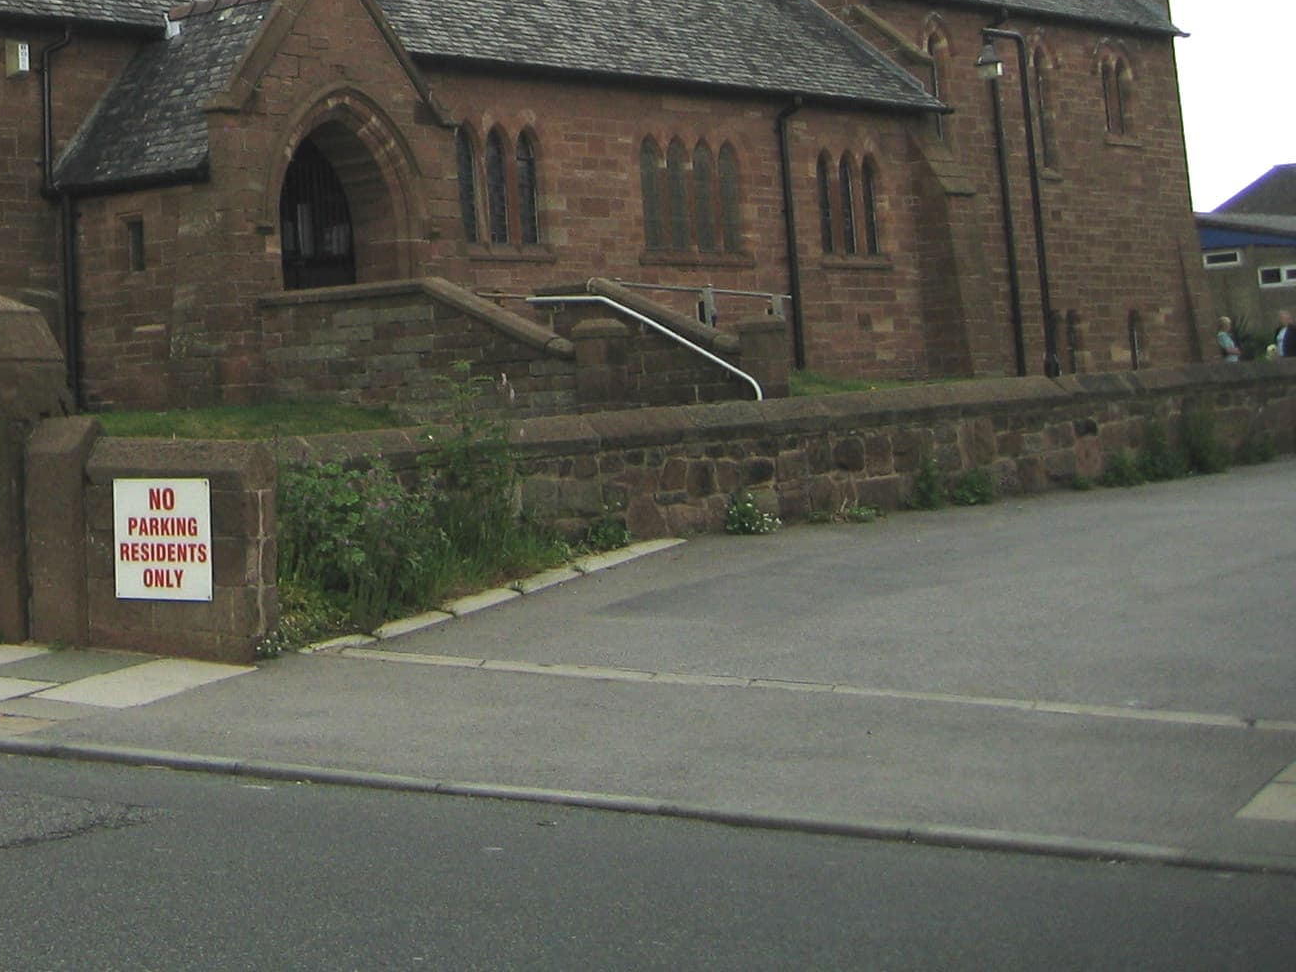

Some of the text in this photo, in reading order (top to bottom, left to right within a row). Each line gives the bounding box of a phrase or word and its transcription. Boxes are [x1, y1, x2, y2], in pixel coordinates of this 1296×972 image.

[149, 488, 175, 510] NO
[128, 517, 198, 537] PARKING
[120, 543, 207, 563] RESIDENTS
[143, 569, 184, 588] ONLY
